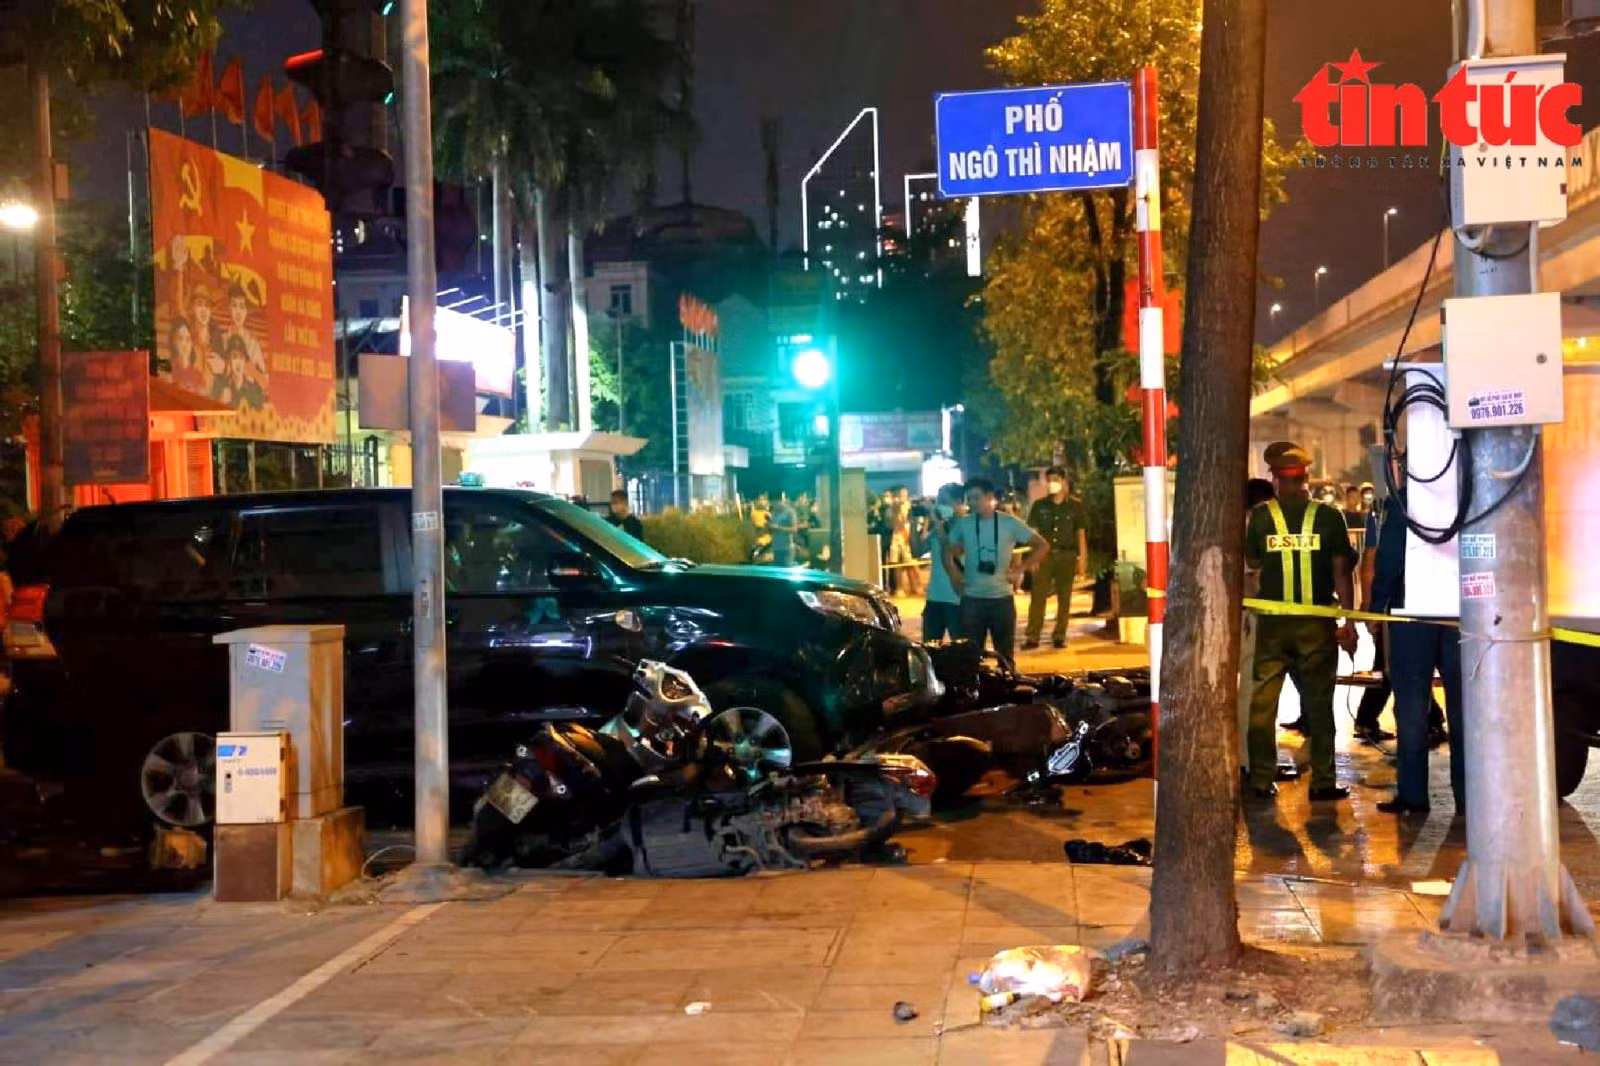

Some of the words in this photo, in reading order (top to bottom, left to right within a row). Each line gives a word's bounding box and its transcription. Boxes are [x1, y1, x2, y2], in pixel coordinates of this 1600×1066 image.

[1005, 91, 1063, 135] PHỐ
[949, 144, 998, 180] NGÔ
[1005, 141, 1042, 176] THÌ
[1050, 138, 1121, 177] NHẬM
